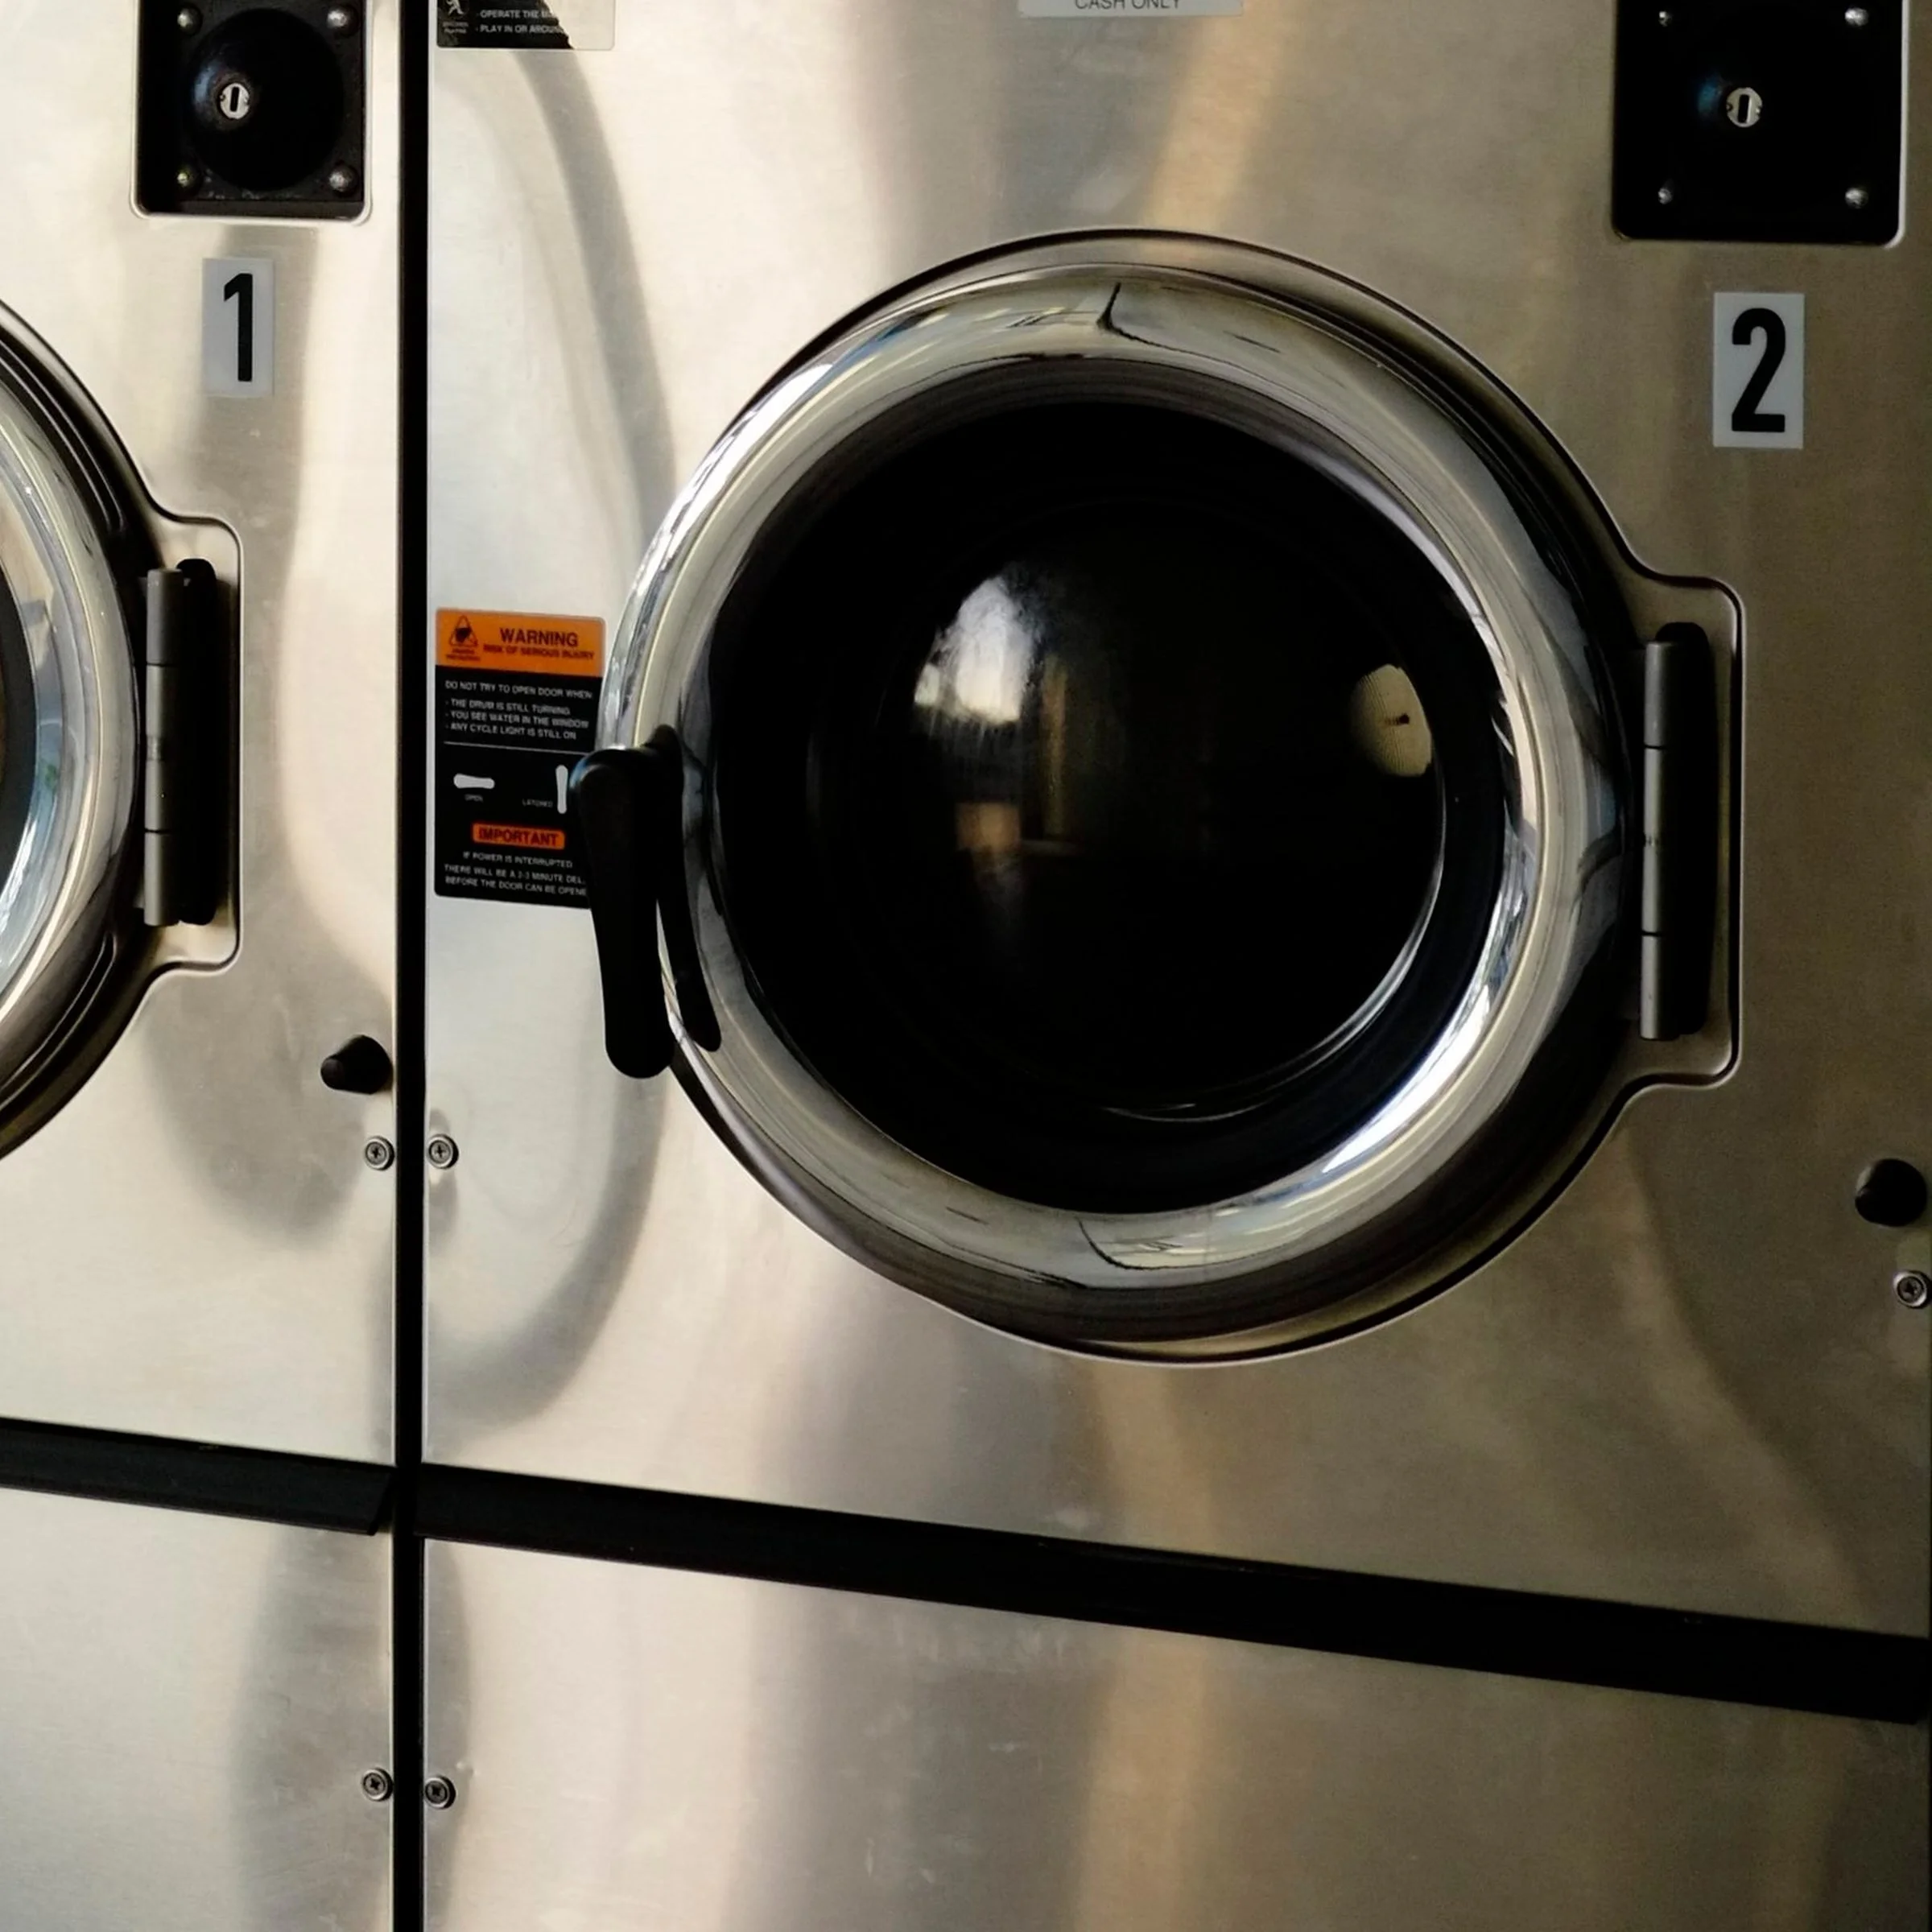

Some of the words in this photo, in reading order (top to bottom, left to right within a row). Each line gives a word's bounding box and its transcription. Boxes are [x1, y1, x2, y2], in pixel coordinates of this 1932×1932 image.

[480, 9, 521, 19] OPERATE
[522, 9, 539, 19] THE
[1075, 0, 1125, 10] CASH
[1132, 0, 1179, 10] ONLY
[480, 23, 502, 33] PLAY
[504, 24, 514, 33] IN
[514, 24, 528, 34] OR
[224, 273, 253, 382] 1
[1732, 308, 1786, 433] 2
[500, 627, 578, 647] WARNING
[484, 644, 503, 654] RISK
[506, 646, 518, 654] OF
[521, 646, 559, 658] SERIOUS
[561, 649, 595, 660] INJURY
[445, 680, 458, 690] DO
[460, 681, 477, 691] NOT
[480, 683, 496, 692] TRY
[498, 684, 510, 693] TO
[512, 684, 536, 696] OPEN
[538, 687, 564, 697] DOOR
[566, 688, 592, 700] WHEN
[451, 698, 467, 708] THE
[469, 700, 494, 710] DRUM
[496, 701, 504, 711] IS
[506, 702, 529, 712] STILL
[532, 704, 571, 716] TURNING
[451, 710, 469, 720] YOU
[471, 712, 487, 721] SEE
[489, 713, 520, 724] WATER
[522, 715, 531, 724] IN
[533, 716, 550, 726] THE
[551, 717, 589, 729] WINDOW
[451, 723, 469, 732] ANY
[469, 724, 497, 734] CYCLE
[500, 726, 525, 737] LIGHT
[527, 728, 535, 737] IS
[538, 729, 561, 739] STILL
[563, 730, 576, 740] ON
[477, 827, 559, 847] IMPORTANT
[463, 851, 471, 859] IF
[473, 852, 503, 863] POWER
[505, 854, 512, 864] IS
[514, 855, 573, 869] INTERRUPTED
[444, 864, 471, 874] THERE
[473, 865, 493, 877] WILL
[496, 868, 507, 877] BE
[509, 869, 517, 878] A
[531, 871, 564, 883] MINUTE
[445, 875, 479, 886] BEFORE
[481, 877, 496, 888] THE
[498, 880, 522, 890] DOOR
[525, 882, 543, 893] CAN
[544, 884, 556, 894] BE
